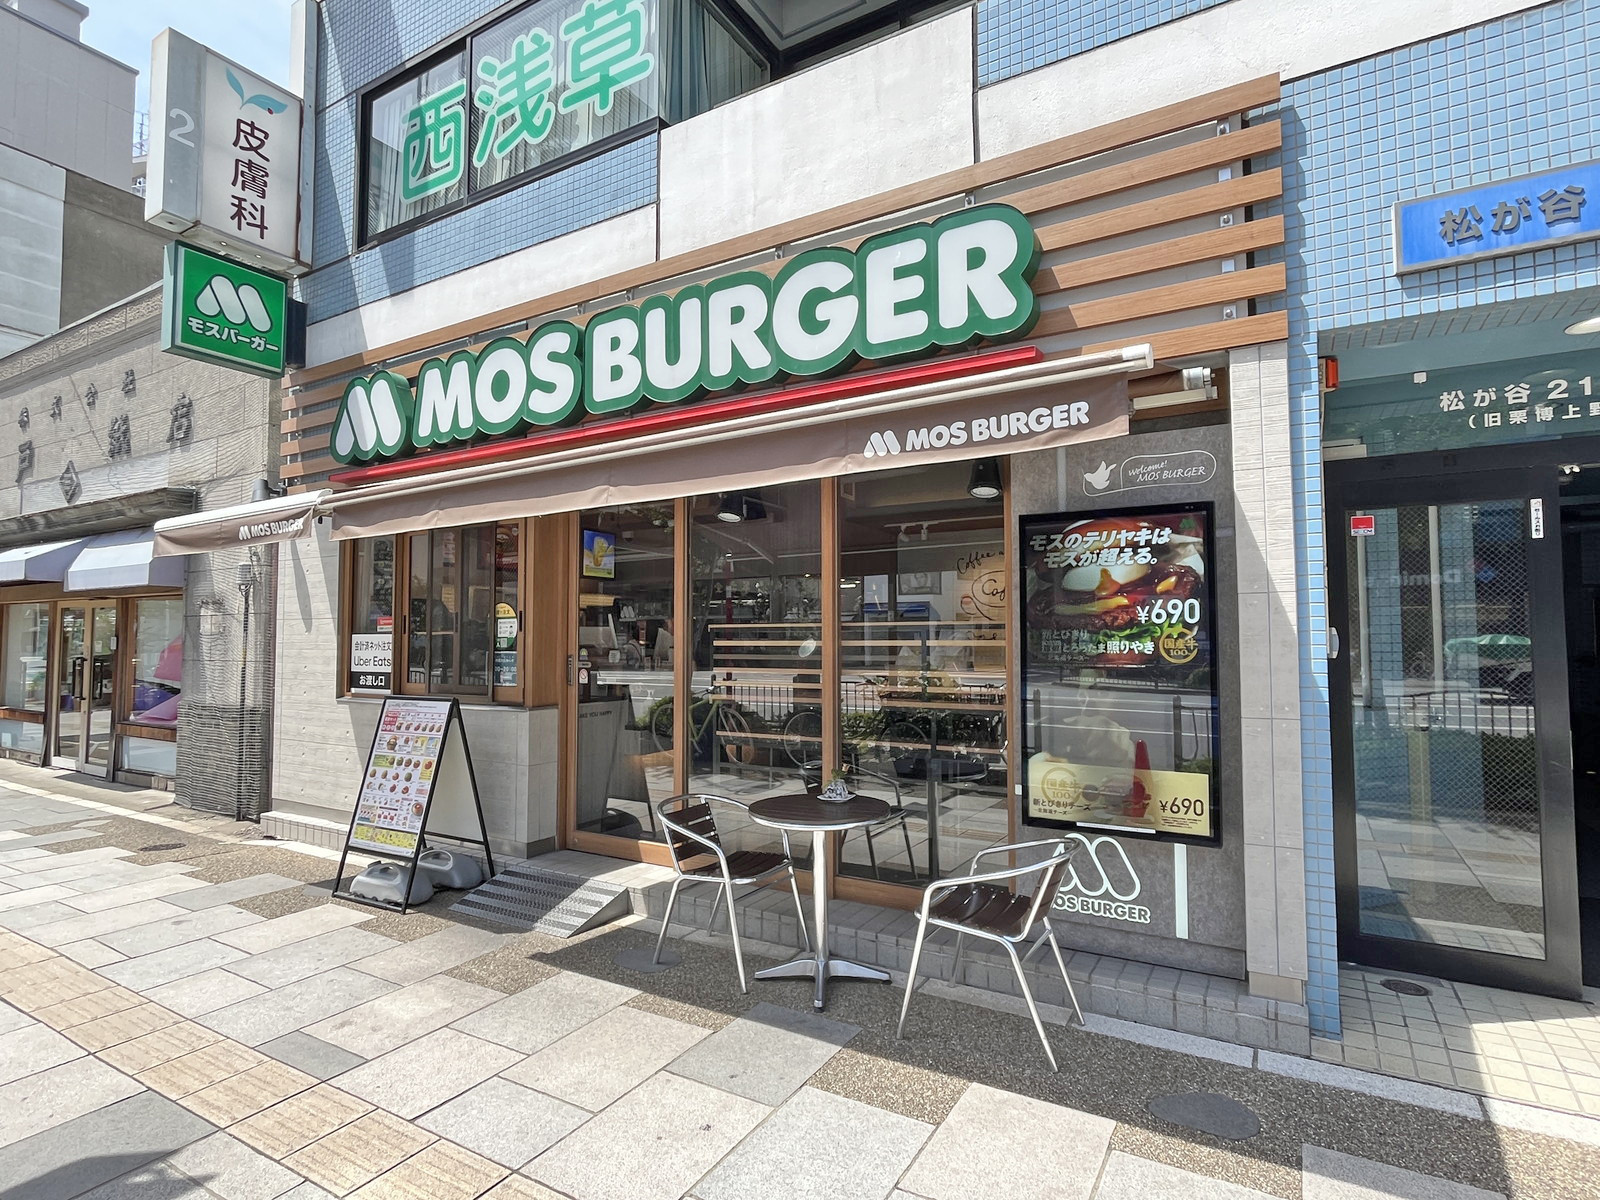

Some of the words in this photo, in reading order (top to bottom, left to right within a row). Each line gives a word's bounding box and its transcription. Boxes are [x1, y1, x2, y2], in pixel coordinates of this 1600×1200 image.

[401, 0, 655, 201] 西浅草
[230, 119, 270, 240] 皮膚科
[1440, 185, 1586, 245] 松が谷
[187, 316, 279, 351] モスバーガー
[416, 331, 577, 438] MOS
[592, 219, 1019, 403] BURGER
[906, 421, 968, 451] MOS
[972, 401, 1089, 441] BURGER
[1137, 470, 1160, 482] MOS
[1162, 465, 1206, 480] BURGER
[250, 522, 271, 538] MOS
[270, 517, 304, 535] BURGER
[1030, 527, 1173, 551] モスのテリヤキは
[957, 551, 995, 574] Coffee
[1044, 547, 1158, 569] モスが超える。
[1136, 598, 1201, 624] ¥690
[354, 656, 371, 667] Uber
[373, 656, 391, 667] Eats
[359, 674, 385, 686] お渡し口
[1159, 797, 1204, 817] ¥690
[1053, 893, 1079, 912] OS
[1079, 896, 1151, 924] BURGER
